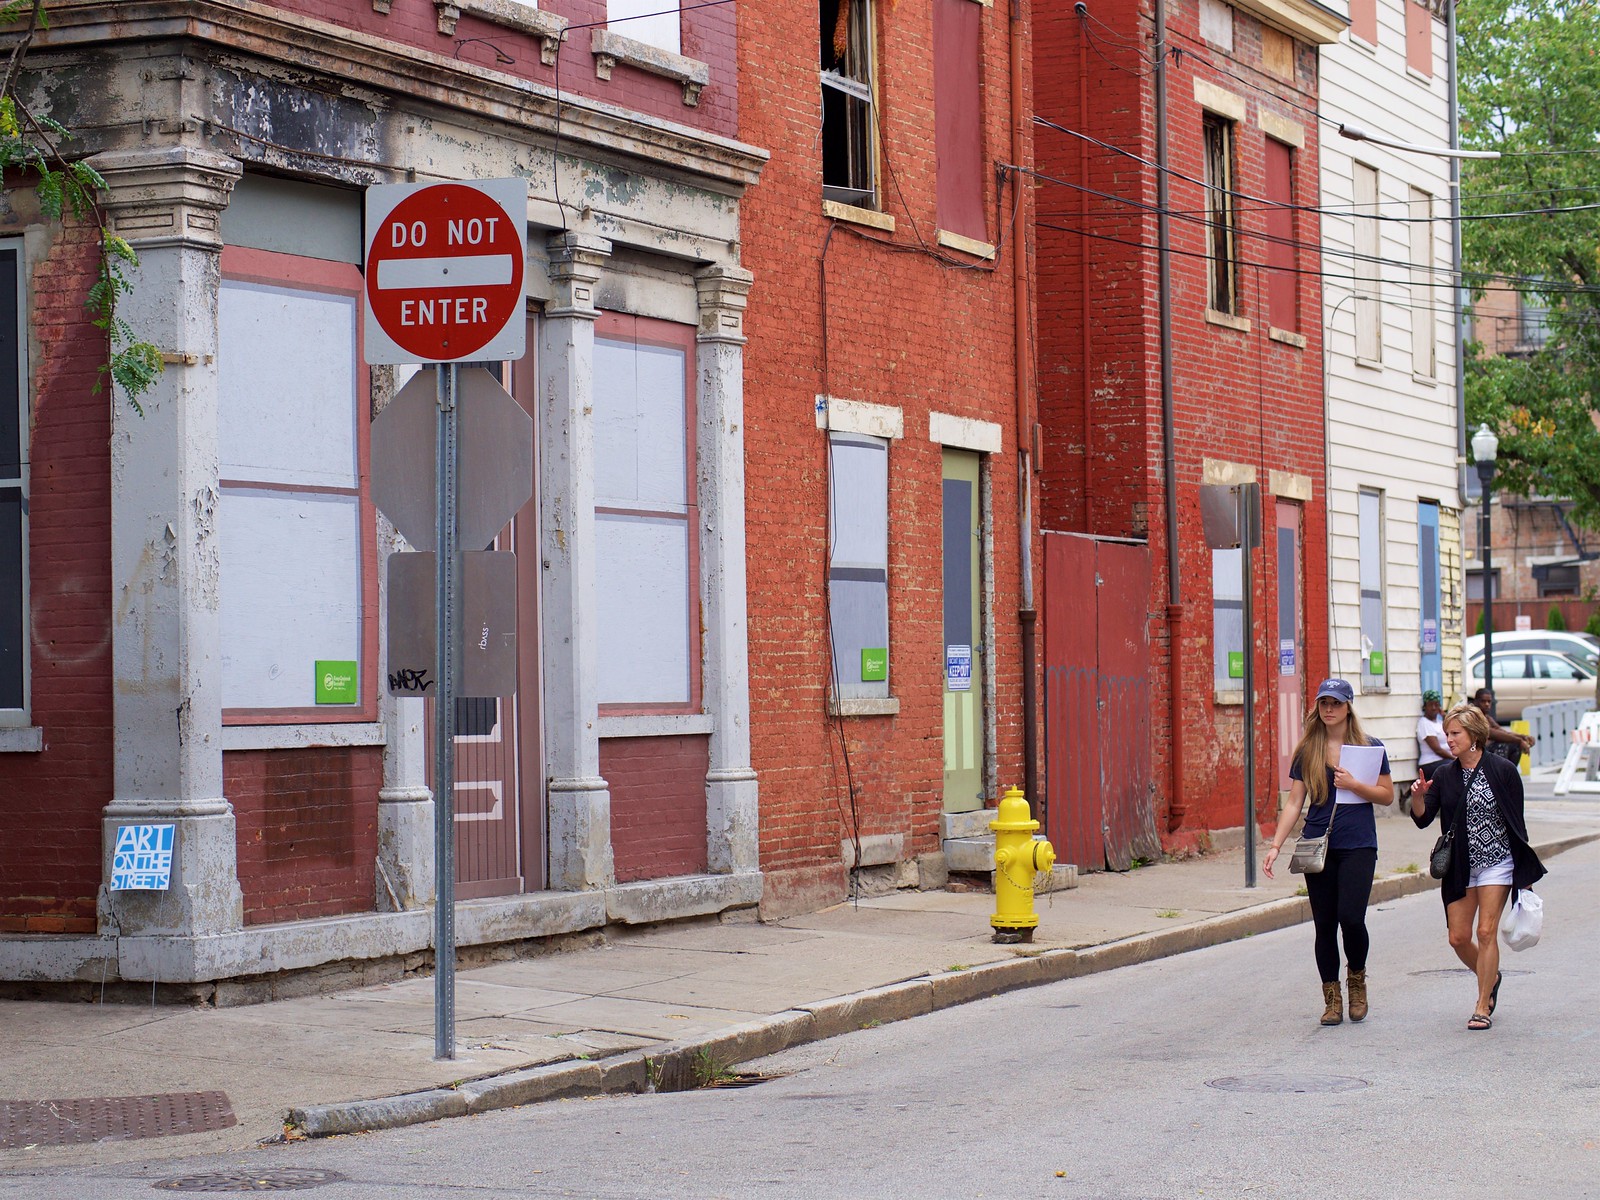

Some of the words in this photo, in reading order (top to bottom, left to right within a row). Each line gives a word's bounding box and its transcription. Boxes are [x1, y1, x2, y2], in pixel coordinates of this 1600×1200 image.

[392, 221, 427, 247] DO
[448, 218, 499, 245] NOT
[401, 298, 488, 326] ENTER
[949, 665, 960, 677] KEEP
[960, 665, 970, 677] OUT
[117, 824, 173, 852] ART
[114, 853, 137, 870] ON
[137, 853, 171, 870] THE
[111, 873, 169, 889] STREETS
